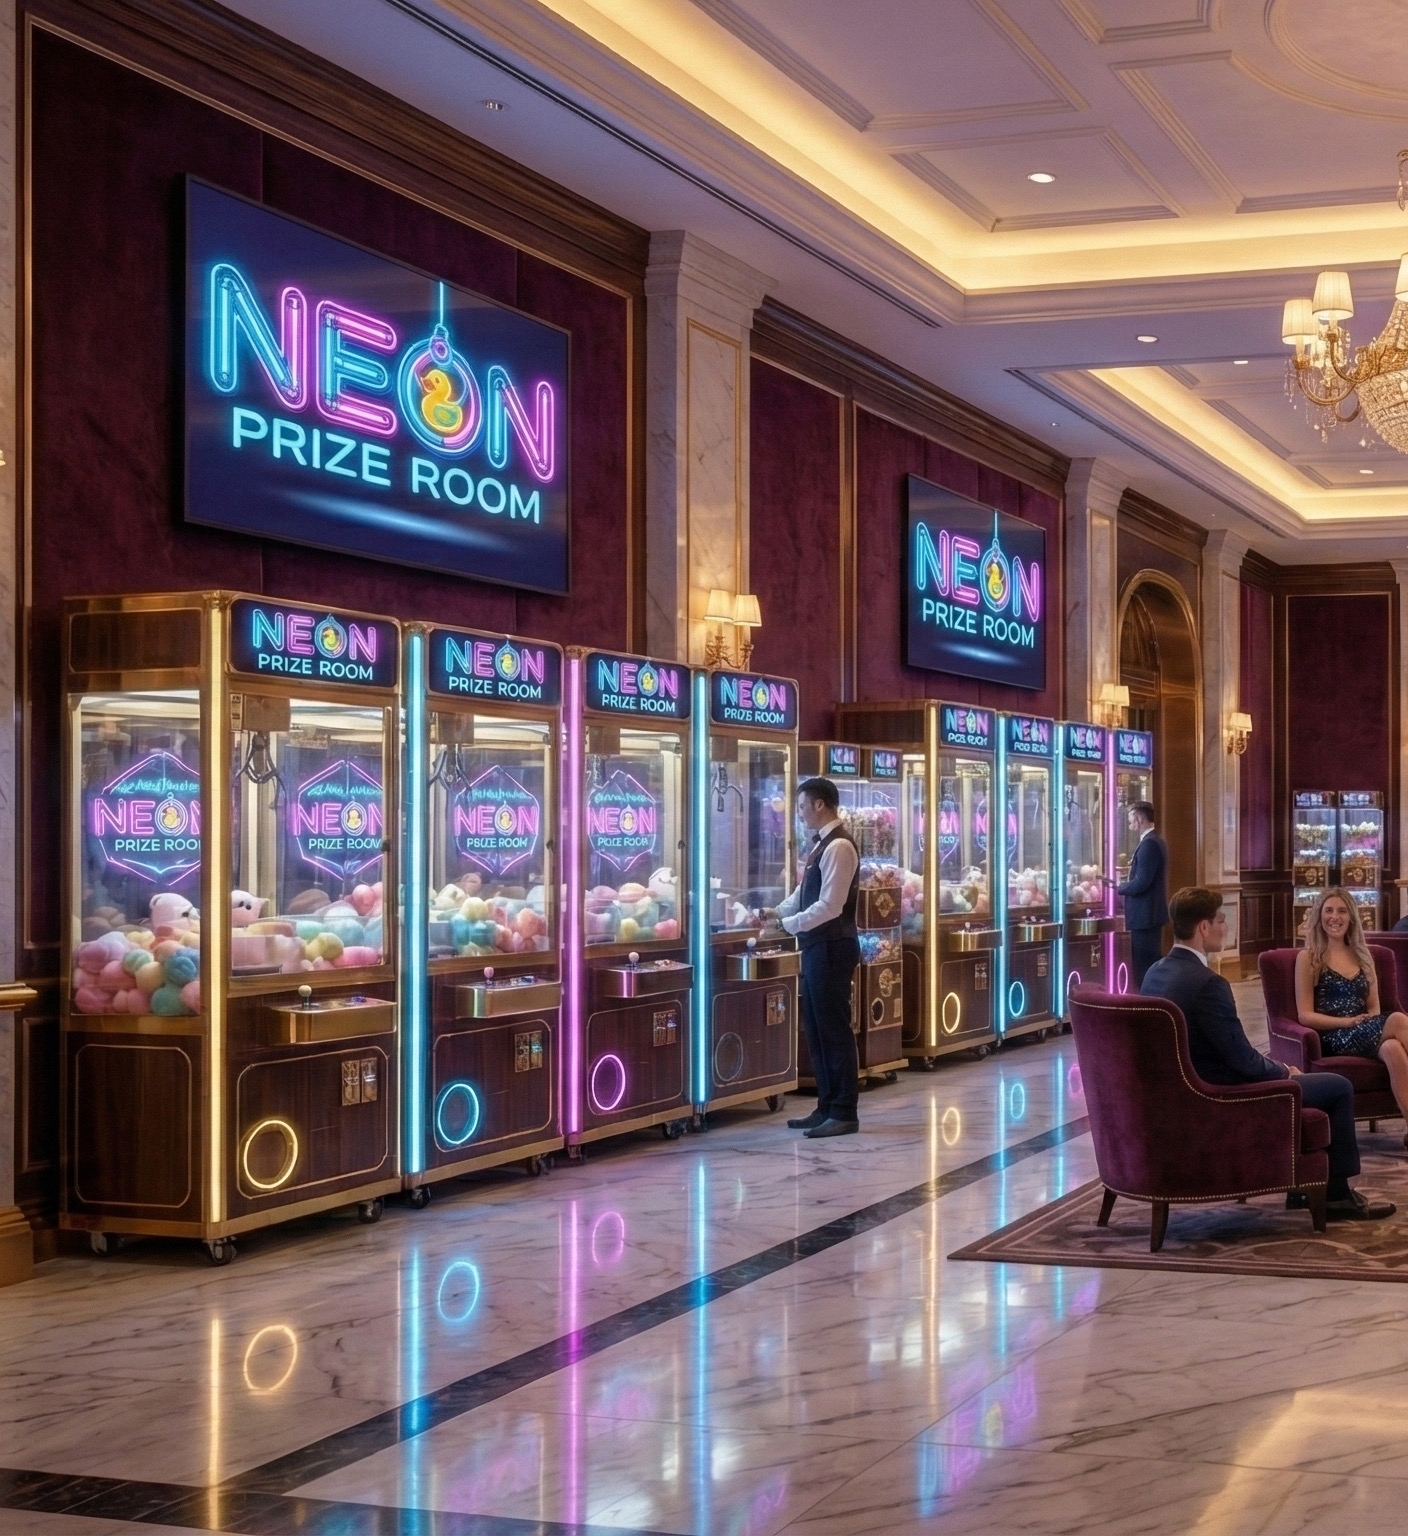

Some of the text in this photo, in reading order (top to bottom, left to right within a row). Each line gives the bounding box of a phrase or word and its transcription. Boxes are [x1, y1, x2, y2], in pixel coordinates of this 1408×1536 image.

[209, 264, 555, 483] NEON
[231, 406, 541, 525] PRIZE ROOM
[916, 521, 1040, 622] NEON
[251, 609, 377, 663] NEON
[922, 598, 1035, 648] PRIZE ROOM
[258, 653, 374, 680] PRIZE ROOM
[445, 637, 545, 684] NEON
[449, 676, 542, 699] PRIZE ROOM
[598, 659, 679, 699] NEON
[720, 676, 787, 711] NEON
[640, 698, 676, 712] ROOM
[945, 708, 989, 736] NEON
[454, 803, 538, 837] NEON
[587, 805, 657, 836] NEON
[115, 839, 200, 852] PRIZE ROO
[308, 838, 345, 850] PRIZE
